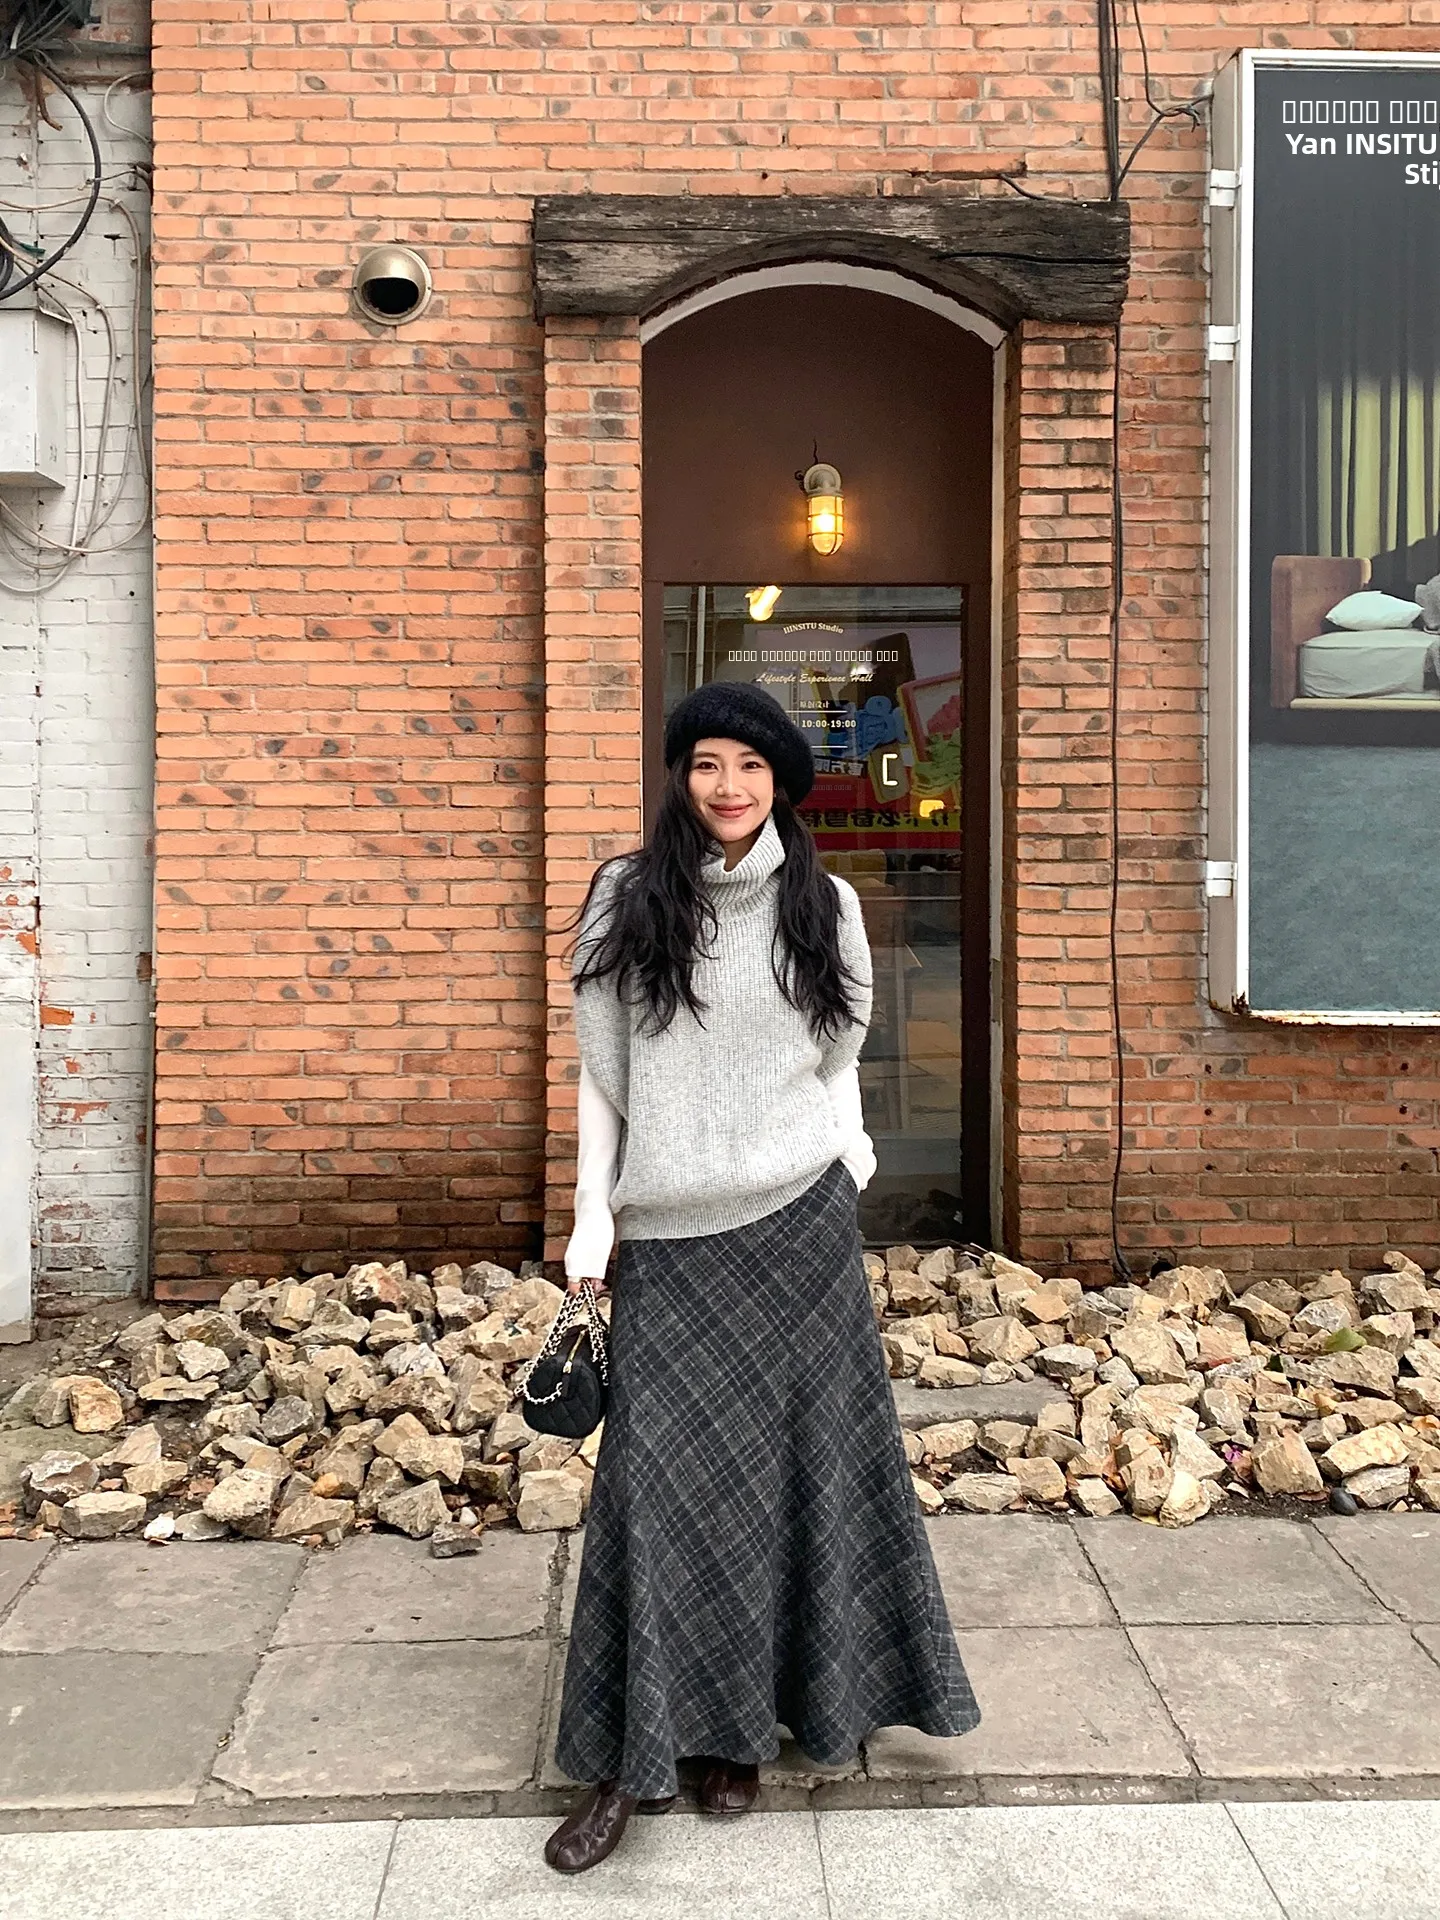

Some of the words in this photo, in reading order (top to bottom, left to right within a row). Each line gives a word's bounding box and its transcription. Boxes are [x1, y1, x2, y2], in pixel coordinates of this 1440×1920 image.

[1285, 133, 1337, 155] Yan
[1346, 133, 1437, 155] INSITU
[1405, 161, 1440, 190] Sti
[818, 622, 844, 634] Studio
[756, 673, 797, 685] Lifestyle
[800, 673, 846, 685] Experience
[850, 673, 874, 683] Hall
[801, 719, 857, 728] 10:00-19:00
